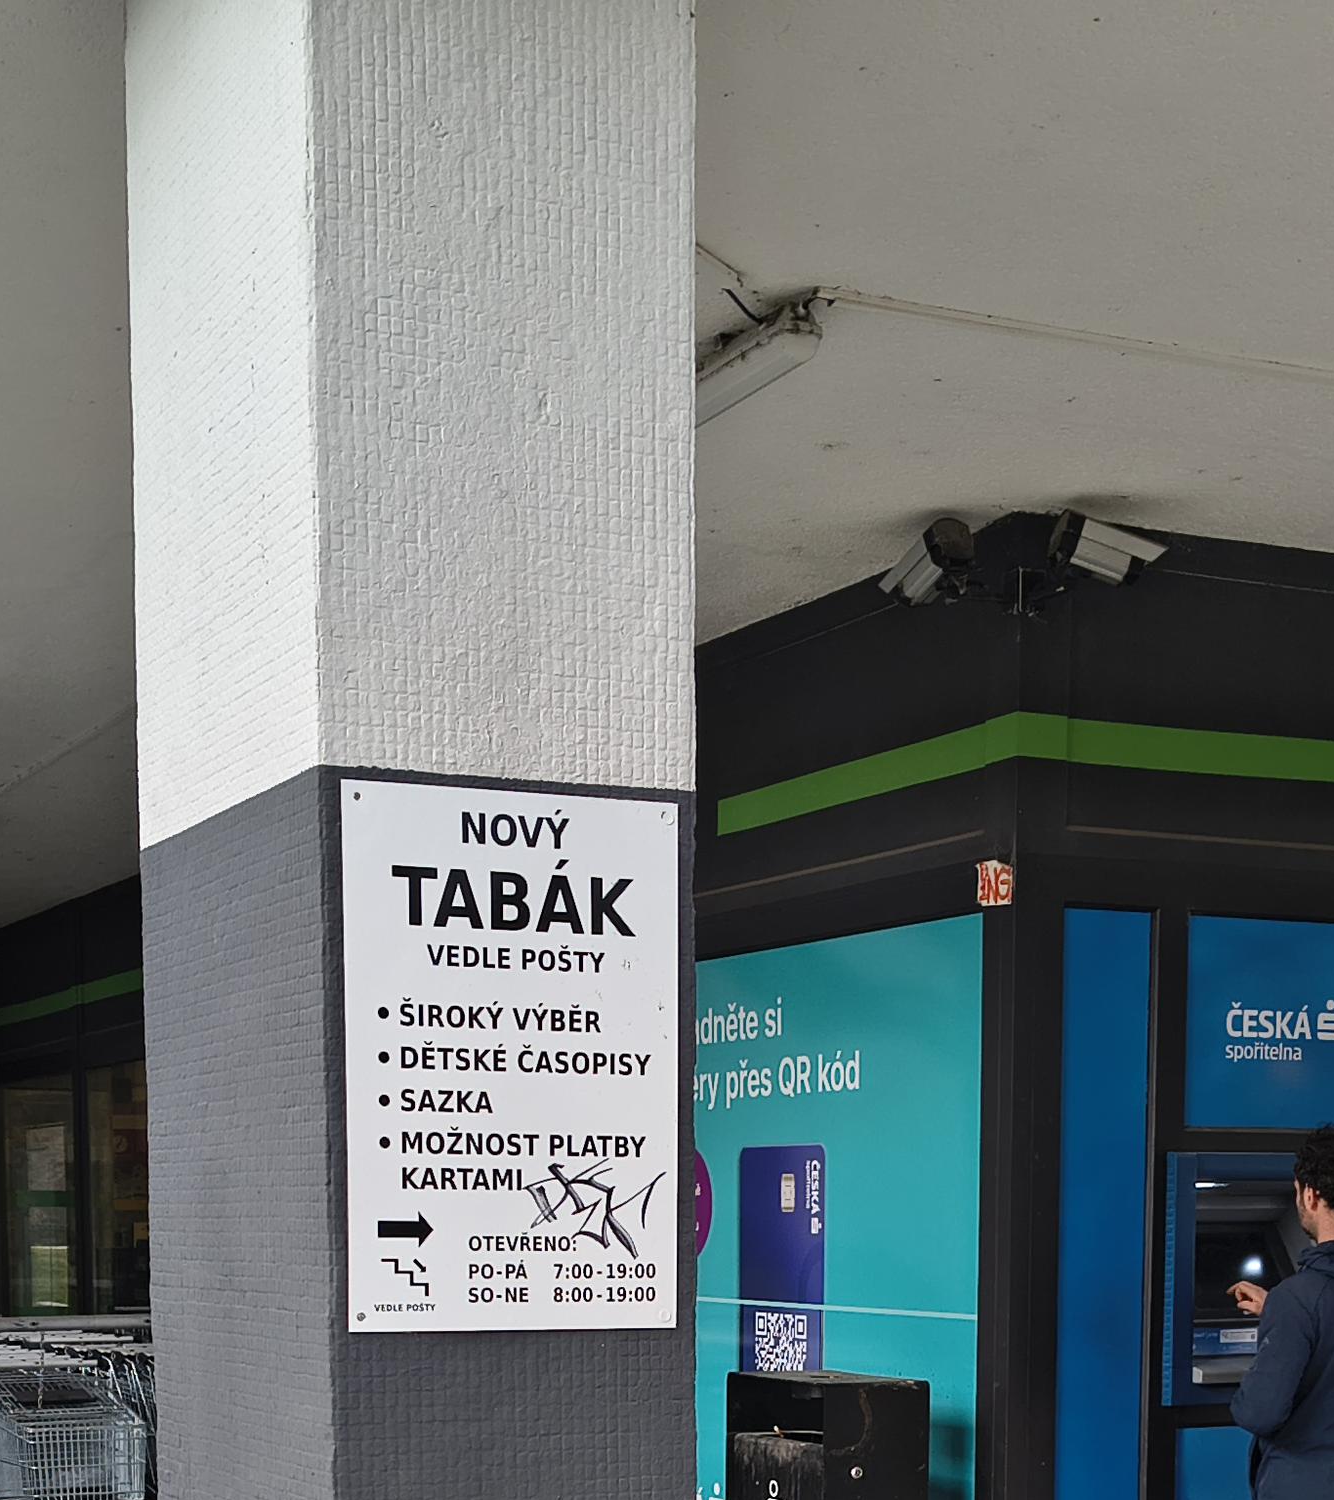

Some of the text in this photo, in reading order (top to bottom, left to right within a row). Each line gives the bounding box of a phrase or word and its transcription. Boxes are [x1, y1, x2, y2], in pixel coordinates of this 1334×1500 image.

[461, 809, 570, 849] NOVÝ
[391, 859, 636, 937] TABÁK
[427, 944, 605, 973] VEDLE POŠTY
[399, 997, 601, 1033] ŠIROKÝ VÝBĚR
[695, 996, 782, 1046] dněte si
[1226, 1001, 1312, 1040] ČESKÁ
[400, 1041, 651, 1076] DĚTSKÉ ČASOPISY
[1225, 1041, 1302, 1062] spořitelna
[726, 1059, 772, 1109] přes
[778, 1056, 811, 1097] QR
[818, 1050, 860, 1093] kód
[400, 1088, 493, 1114] SAZKA
[401, 1126, 646, 1157] MOŽNOST PLATBY
[401, 1167, 523, 1191] KARTAMI
[468, 1232, 577, 1252] OTEVŘENO:
[468, 1259, 528, 1280] PO-PÁ
[374, 1303, 436, 1312] VEDLE POŠTY
[468, 1287, 529, 1303] SO-NE
